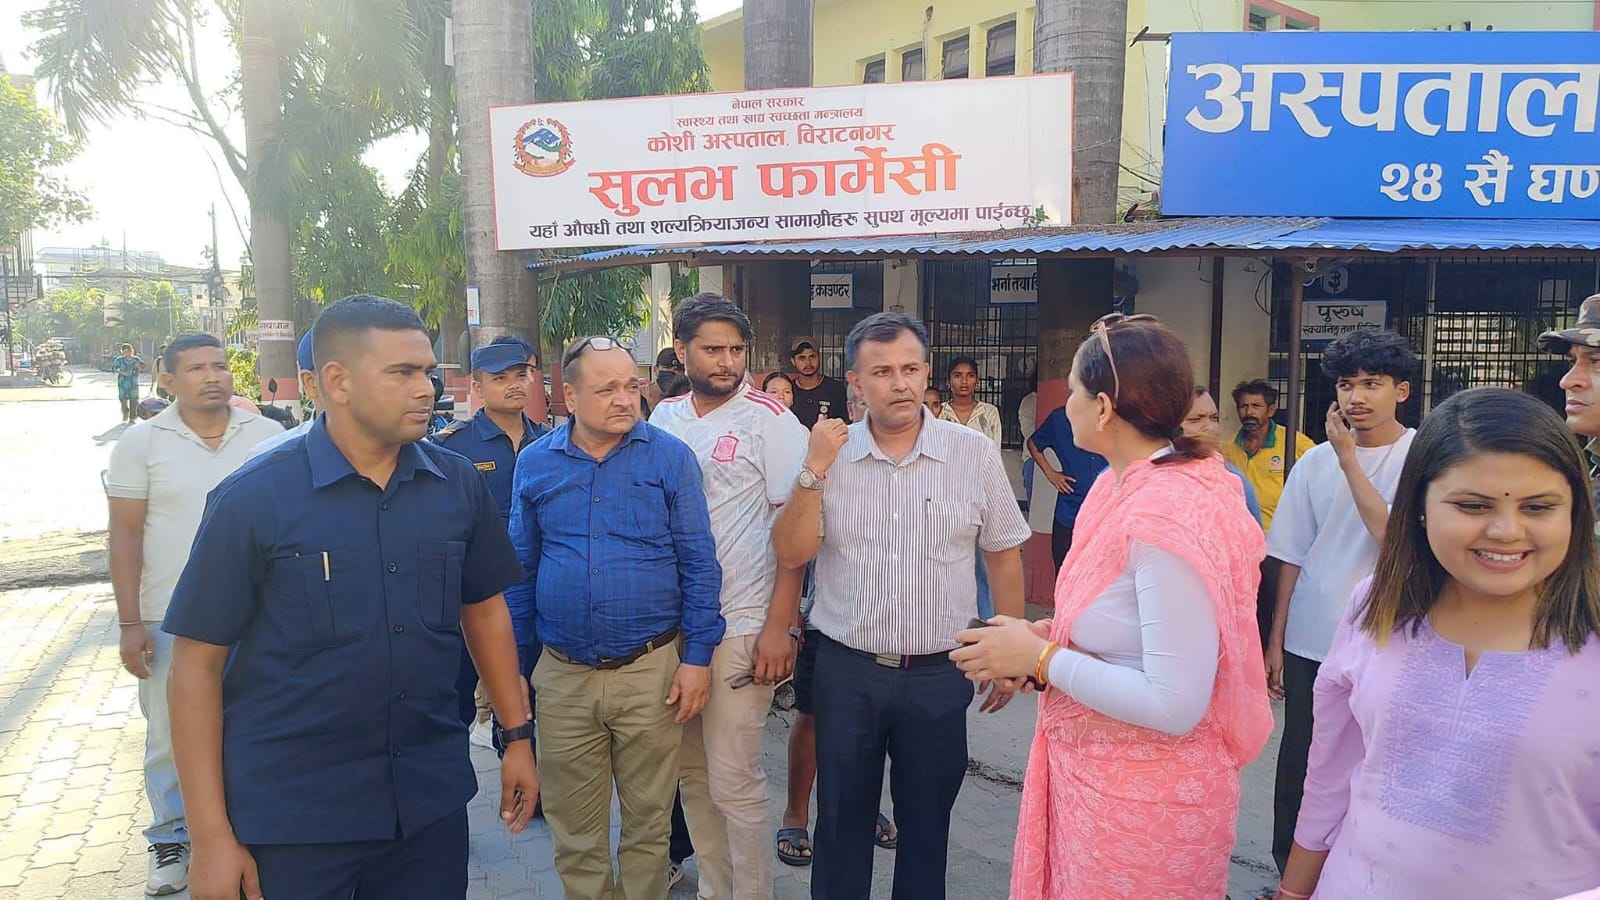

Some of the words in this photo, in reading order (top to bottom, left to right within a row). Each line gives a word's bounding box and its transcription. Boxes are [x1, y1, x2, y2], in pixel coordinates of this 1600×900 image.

[731, 97, 763, 110] नेपाल
[766, 96, 806, 108] सरकार
[1185, 63, 1600, 138] अस्पताल
[676, 116, 715, 129] स्वास्थ्य
[718, 115, 739, 126] तथा
[743, 113, 765, 125] खाद्य
[769, 111, 811, 125] स्वच्छता
[814, 107, 864, 120] मन्त्रालय
[647, 131, 696, 153] कोशी
[796, 122, 897, 146] विराटनगर
[587, 165, 738, 217] सुलभ
[757, 143, 962, 198] फार्मेसी
[1380, 162, 1443, 202] २४
[1464, 149, 1514, 206] सै
[529, 220, 559, 239] यहाँ
[563, 218, 612, 237] औषधी
[616, 220, 646, 235] तथा
[650, 214, 770, 235] शल्यक्रियाजन्य
[864, 209, 906, 228] सुपथ
[910, 206, 970, 227] मूल्यमा
